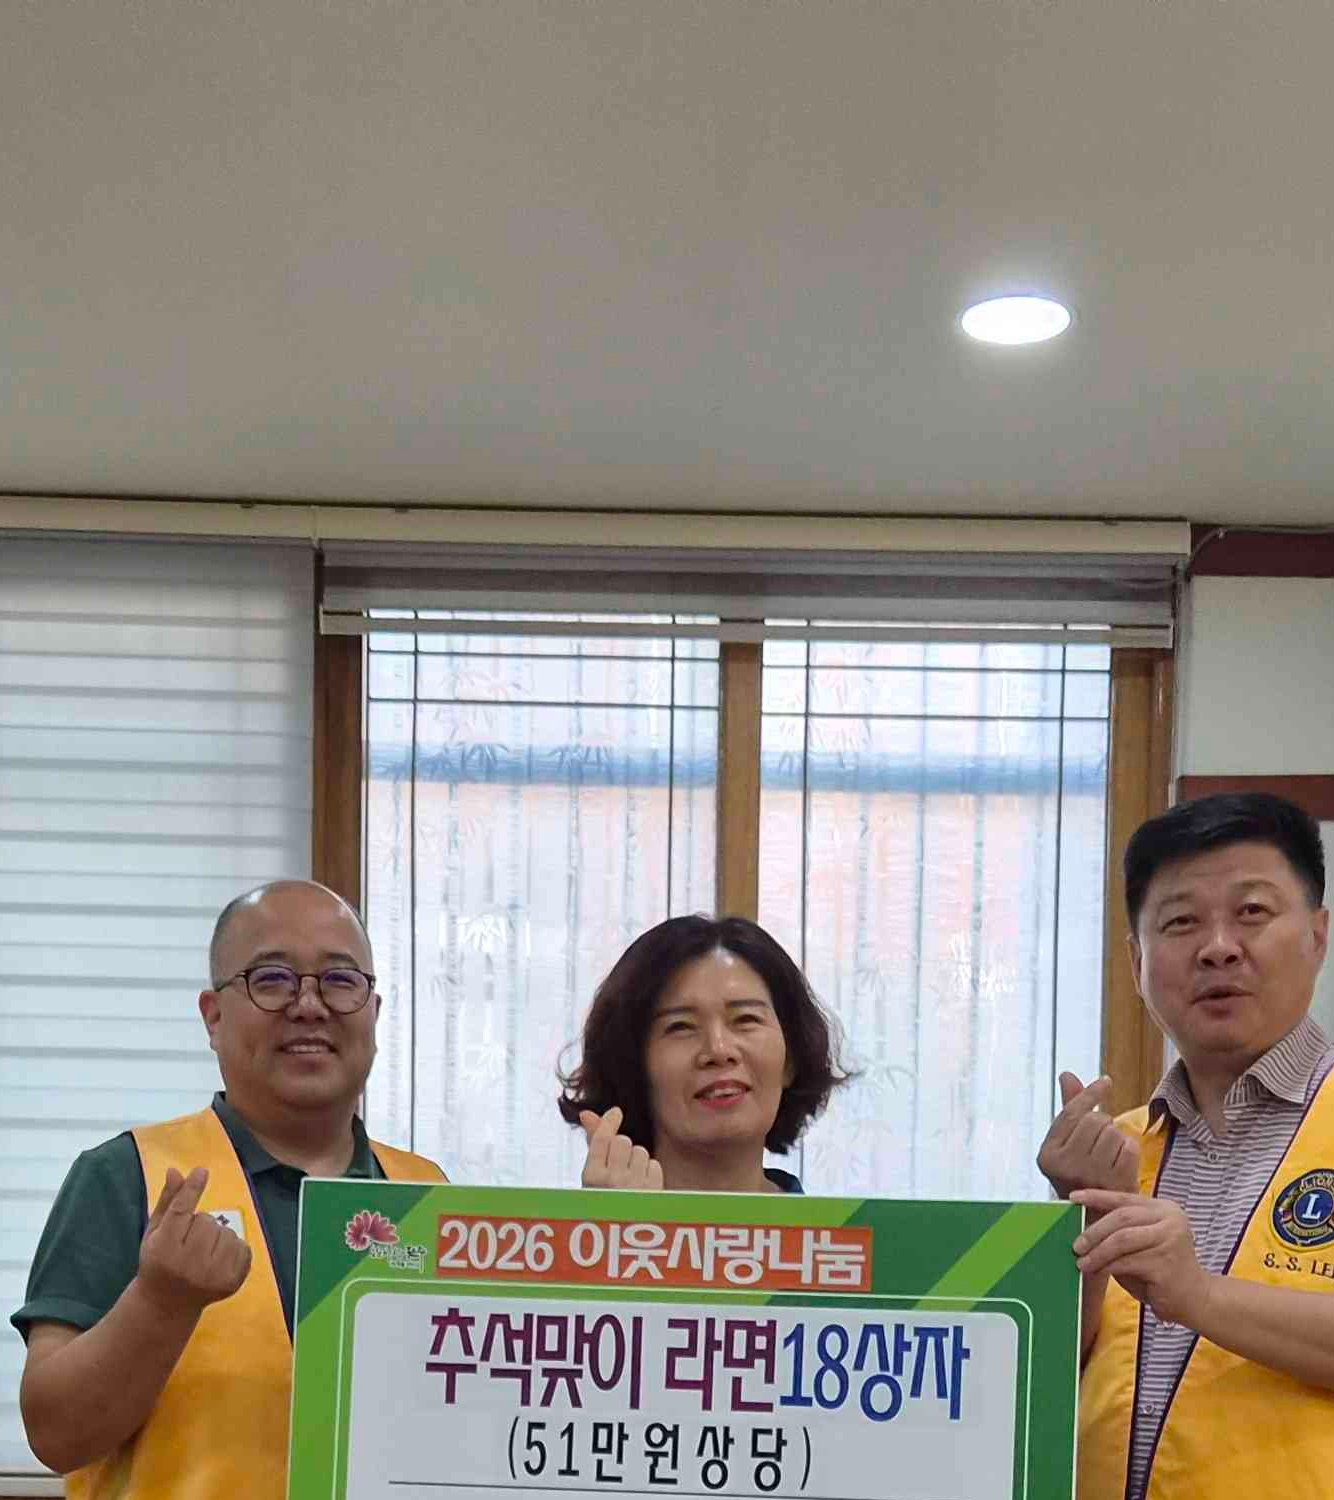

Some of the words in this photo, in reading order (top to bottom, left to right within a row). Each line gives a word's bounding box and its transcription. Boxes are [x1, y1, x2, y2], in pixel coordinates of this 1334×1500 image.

[1302, 1194, 1321, 1219] L
[439, 1220, 554, 1271] 2026
[569, 1222, 866, 1285] 이웃사랑나눔
[426, 1308, 643, 1409] 추석맞이
[665, 1317, 971, 1422] 라면18상자
